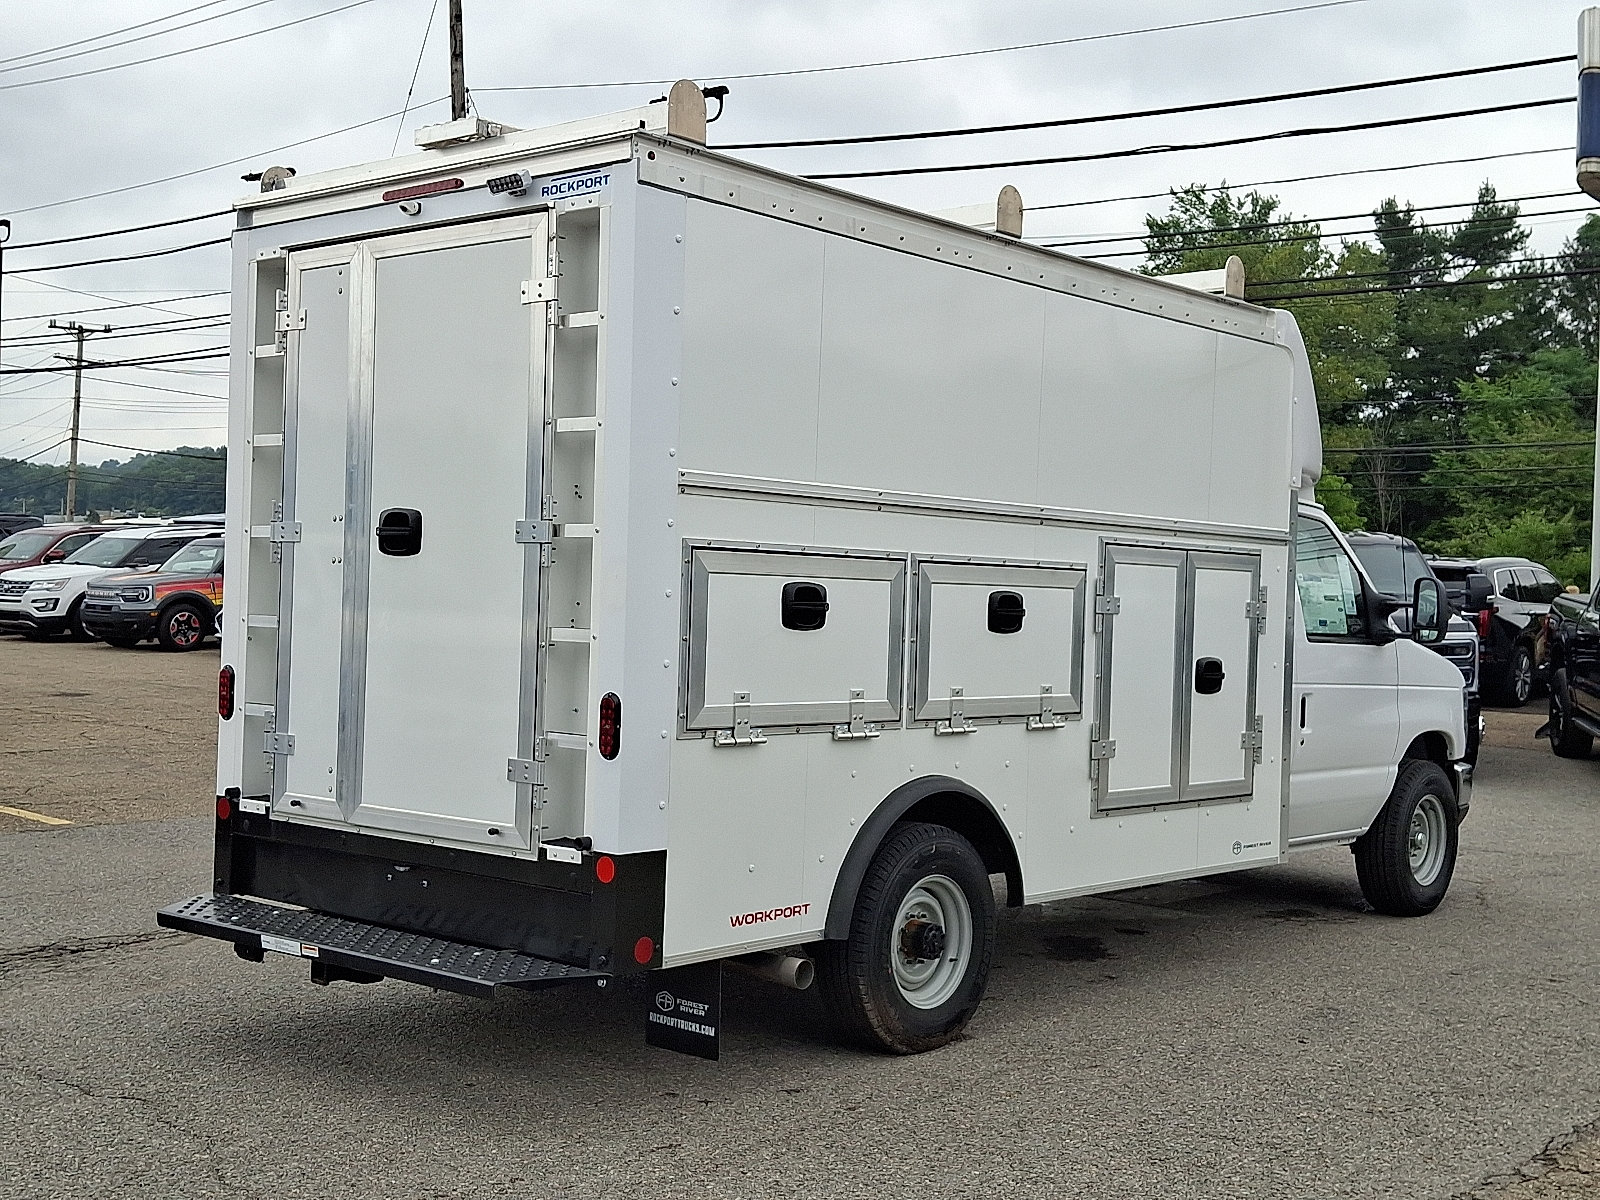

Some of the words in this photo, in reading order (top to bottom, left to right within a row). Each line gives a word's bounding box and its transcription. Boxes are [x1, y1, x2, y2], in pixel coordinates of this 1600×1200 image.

[541, 174, 611, 197] ROCKPORT
[730, 903, 811, 927] WORKPORT
[676, 998, 709, 1011] FOREST
[679, 1005, 705, 1016] RIVER
[649, 1012, 715, 1037] ROCKPORTTRUCKS.COM
